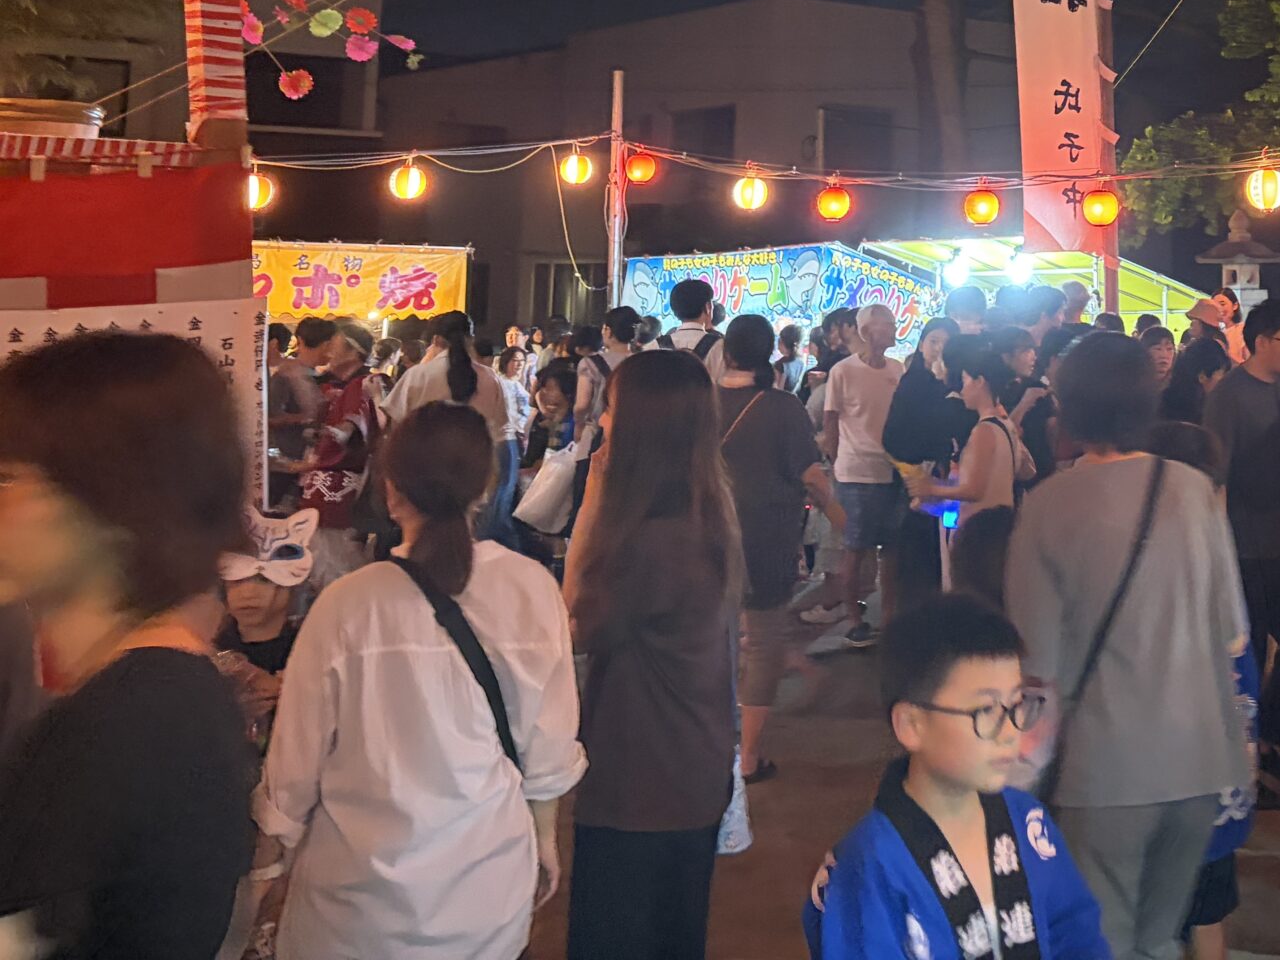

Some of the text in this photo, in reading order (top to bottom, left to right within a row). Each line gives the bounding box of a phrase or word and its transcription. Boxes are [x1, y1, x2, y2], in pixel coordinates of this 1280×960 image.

[659, 263, 789, 314] サりゲーム
